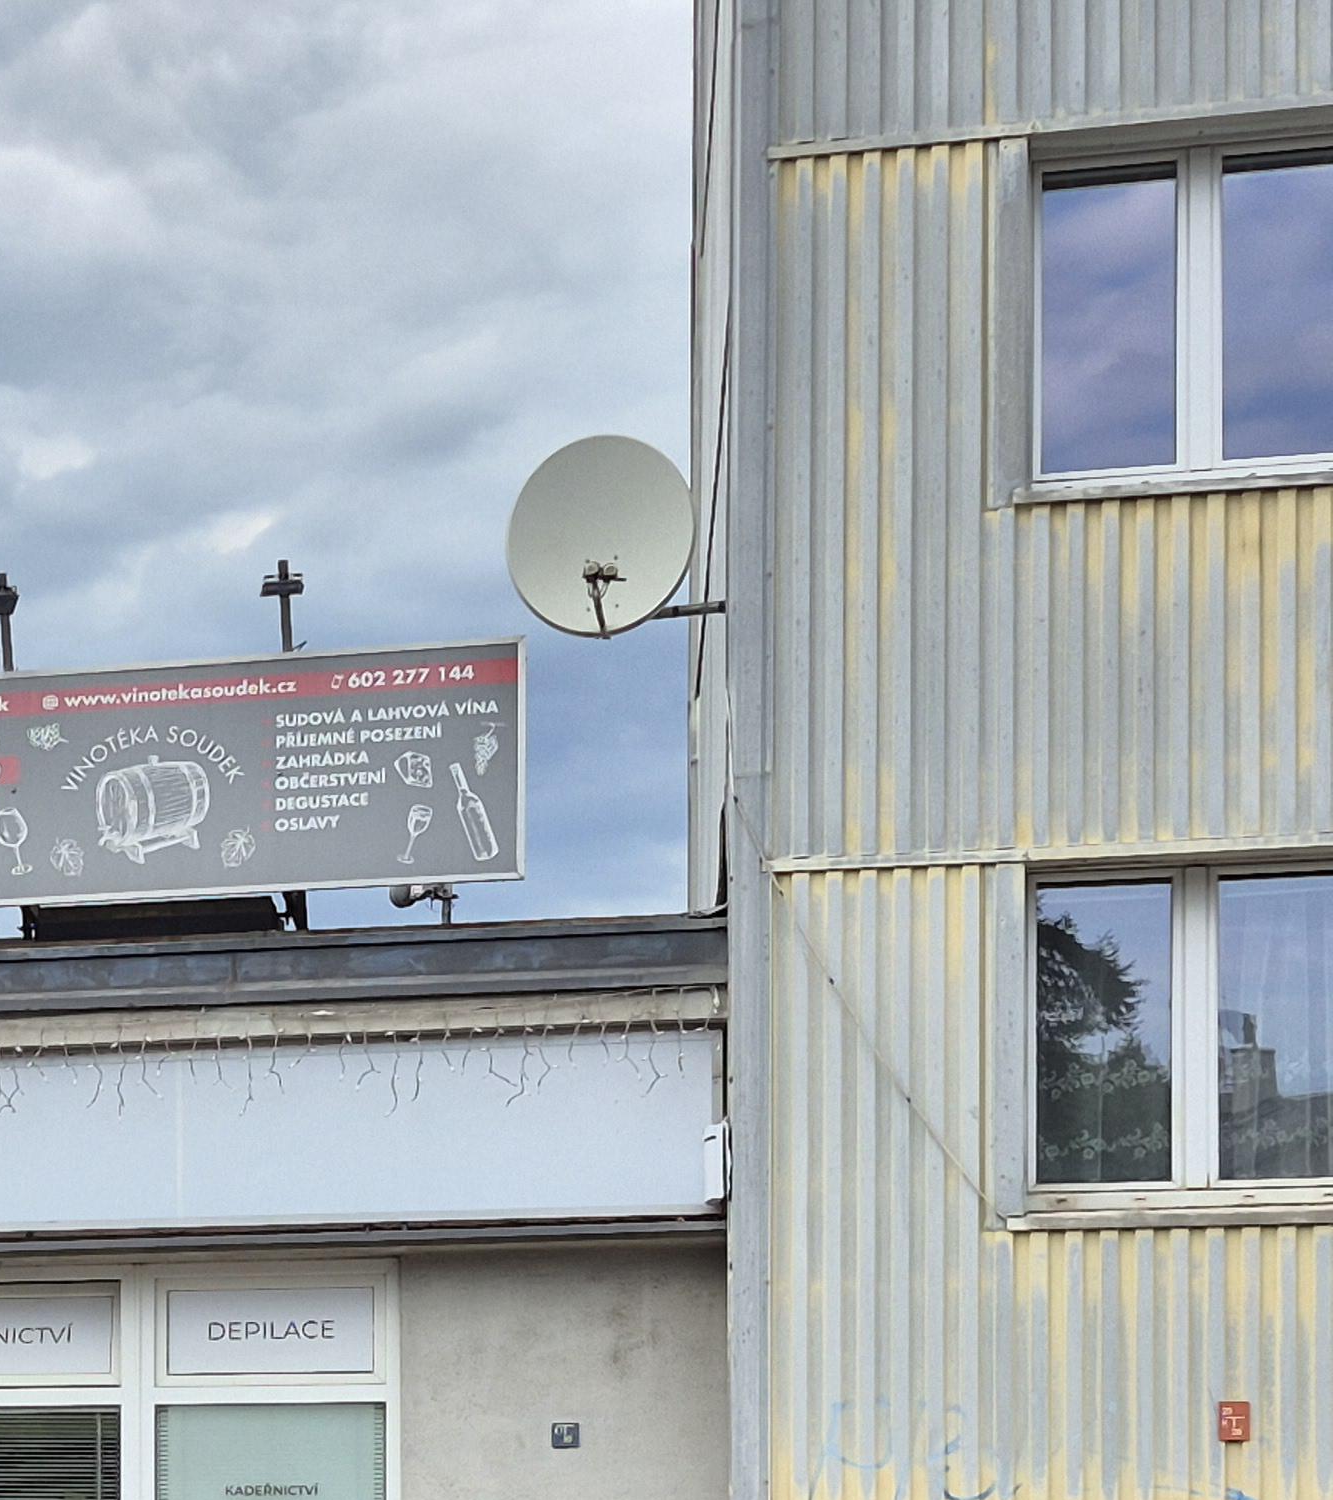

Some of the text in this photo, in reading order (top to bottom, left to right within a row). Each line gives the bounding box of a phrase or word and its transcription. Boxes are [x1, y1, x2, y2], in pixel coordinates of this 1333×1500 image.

[348, 665, 475, 689] 602 277 144
[63, 679, 298, 708] www.vinotekasoudek.cz
[275, 697, 499, 729] SUDOVÁ A LAHVOVÁ VÍNA
[275, 721, 443, 749] PŘÍJEMNÉ POSEZENÍ
[166, 726, 246, 785] SOUDEK
[275, 749, 370, 770] ZAHRÁDKA
[275, 768, 386, 791] OBČERSTVENÍ
[275, 792, 369, 811] DEGUSTACE
[274, 814, 341, 832] OSLAVY
[208, 1320, 335, 1341] DEPILACE
[225, 1482, 319, 1496] KADEŘNICTVÍ
